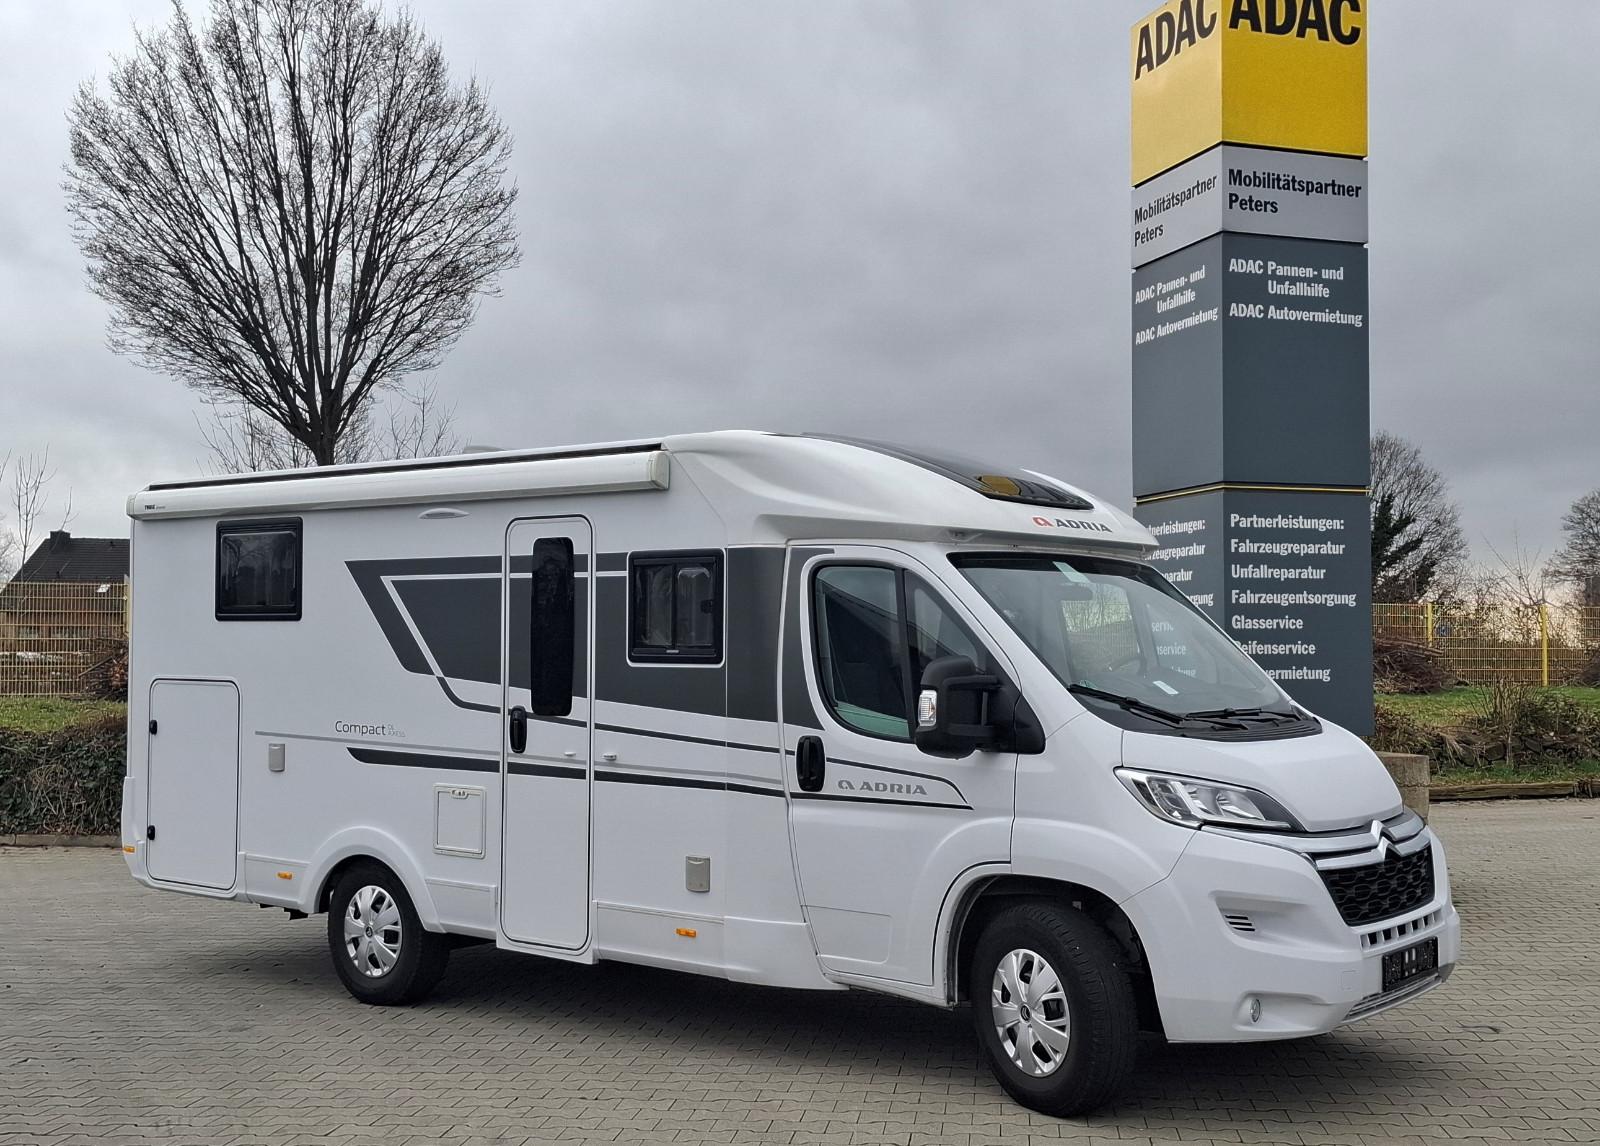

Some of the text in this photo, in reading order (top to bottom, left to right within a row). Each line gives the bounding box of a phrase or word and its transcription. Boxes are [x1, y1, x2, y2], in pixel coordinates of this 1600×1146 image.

[1228, 0, 1361, 45] ADAC
[1135, 0, 1217, 80] ADAC
[1228, 168, 1362, 198] Mobilitätspartner
[1134, 174, 1217, 225] Mobilitätspartner
[1228, 192, 1279, 213] Peters
[1134, 223, 1164, 247] Peters
[1229, 258, 1345, 280] ADAC Pannen- und
[1135, 265, 1206, 304] ADAC Pannen- und
[1267, 280, 1330, 298] Unfallhilfe
[1157, 291, 1196, 314] Unfallhilfe
[1135, 306, 1219, 345] ADAC Autovermietung
[1229, 302, 1363, 328] ADAC Autovermietung
[1054, 518, 1113, 533] ADRIA
[1230, 513, 1345, 532] Partnerleistungen:
[1230, 538, 1346, 556] Fahrzeugreparatur
[1231, 564, 1327, 581] Unfallreparatur
[1231, 590, 1357, 607] Fahrzeugentsorgung
[1231, 615, 1304, 630] Glasservice
[335, 720, 386, 736] Compact
[859, 781, 928, 795] ADRIA
